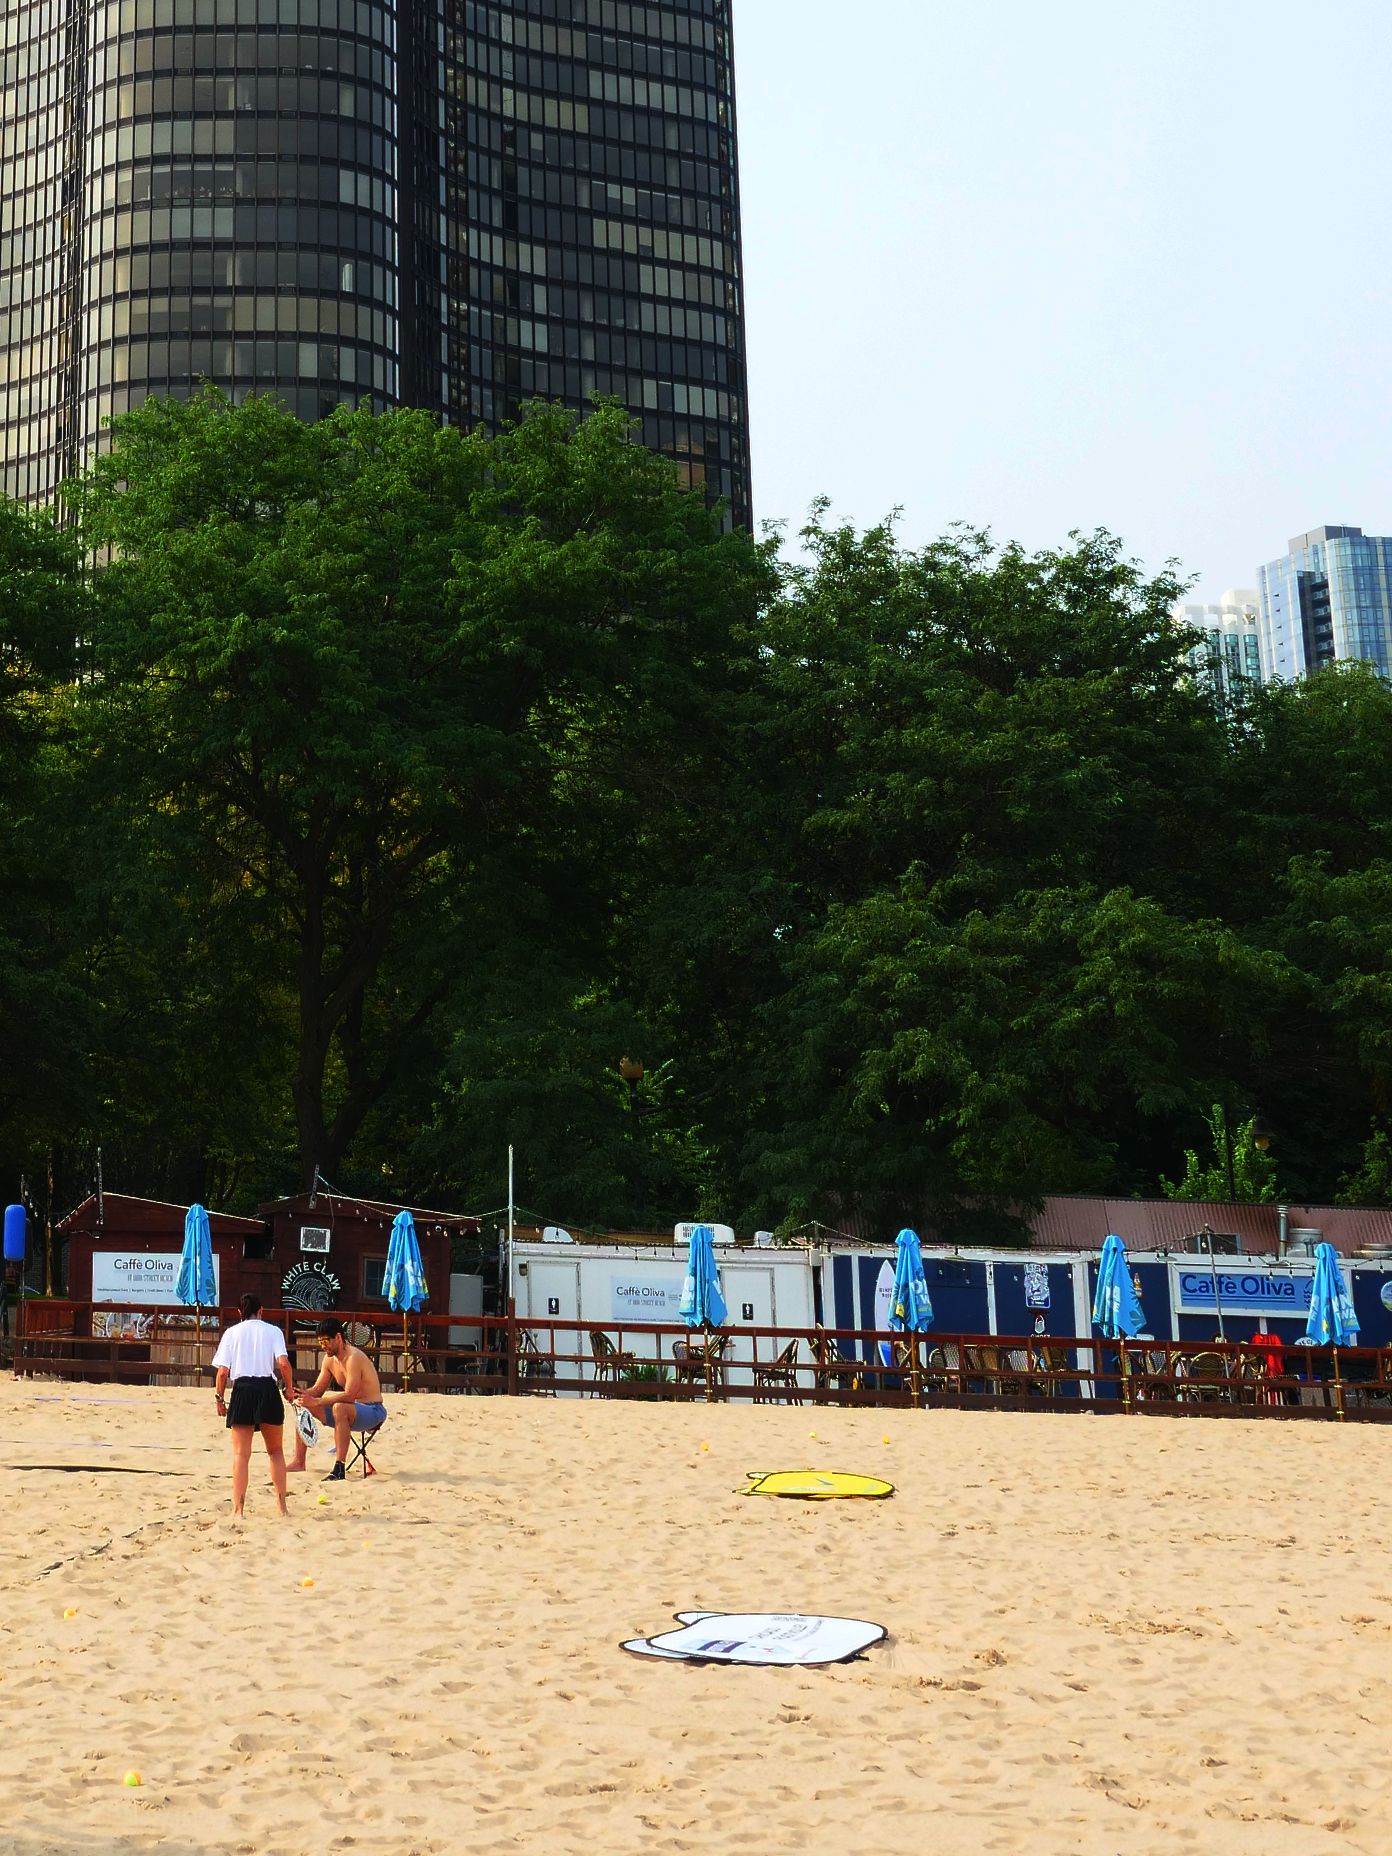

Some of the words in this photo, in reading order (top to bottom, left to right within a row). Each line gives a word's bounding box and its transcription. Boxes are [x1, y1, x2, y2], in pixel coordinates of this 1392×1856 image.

[114, 1259, 143, 1270] Caffè
[145, 1259, 173, 1270] Oliva
[281, 1261, 310, 1290] WHITE
[313, 1262, 341, 1290] CLAW
[616, 1286, 640, 1297] Caffè
[641, 1287, 665, 1297] Oliva
[1182, 1274, 1237, 1295] Caffè
[1241, 1275, 1295, 1296] Oliva
